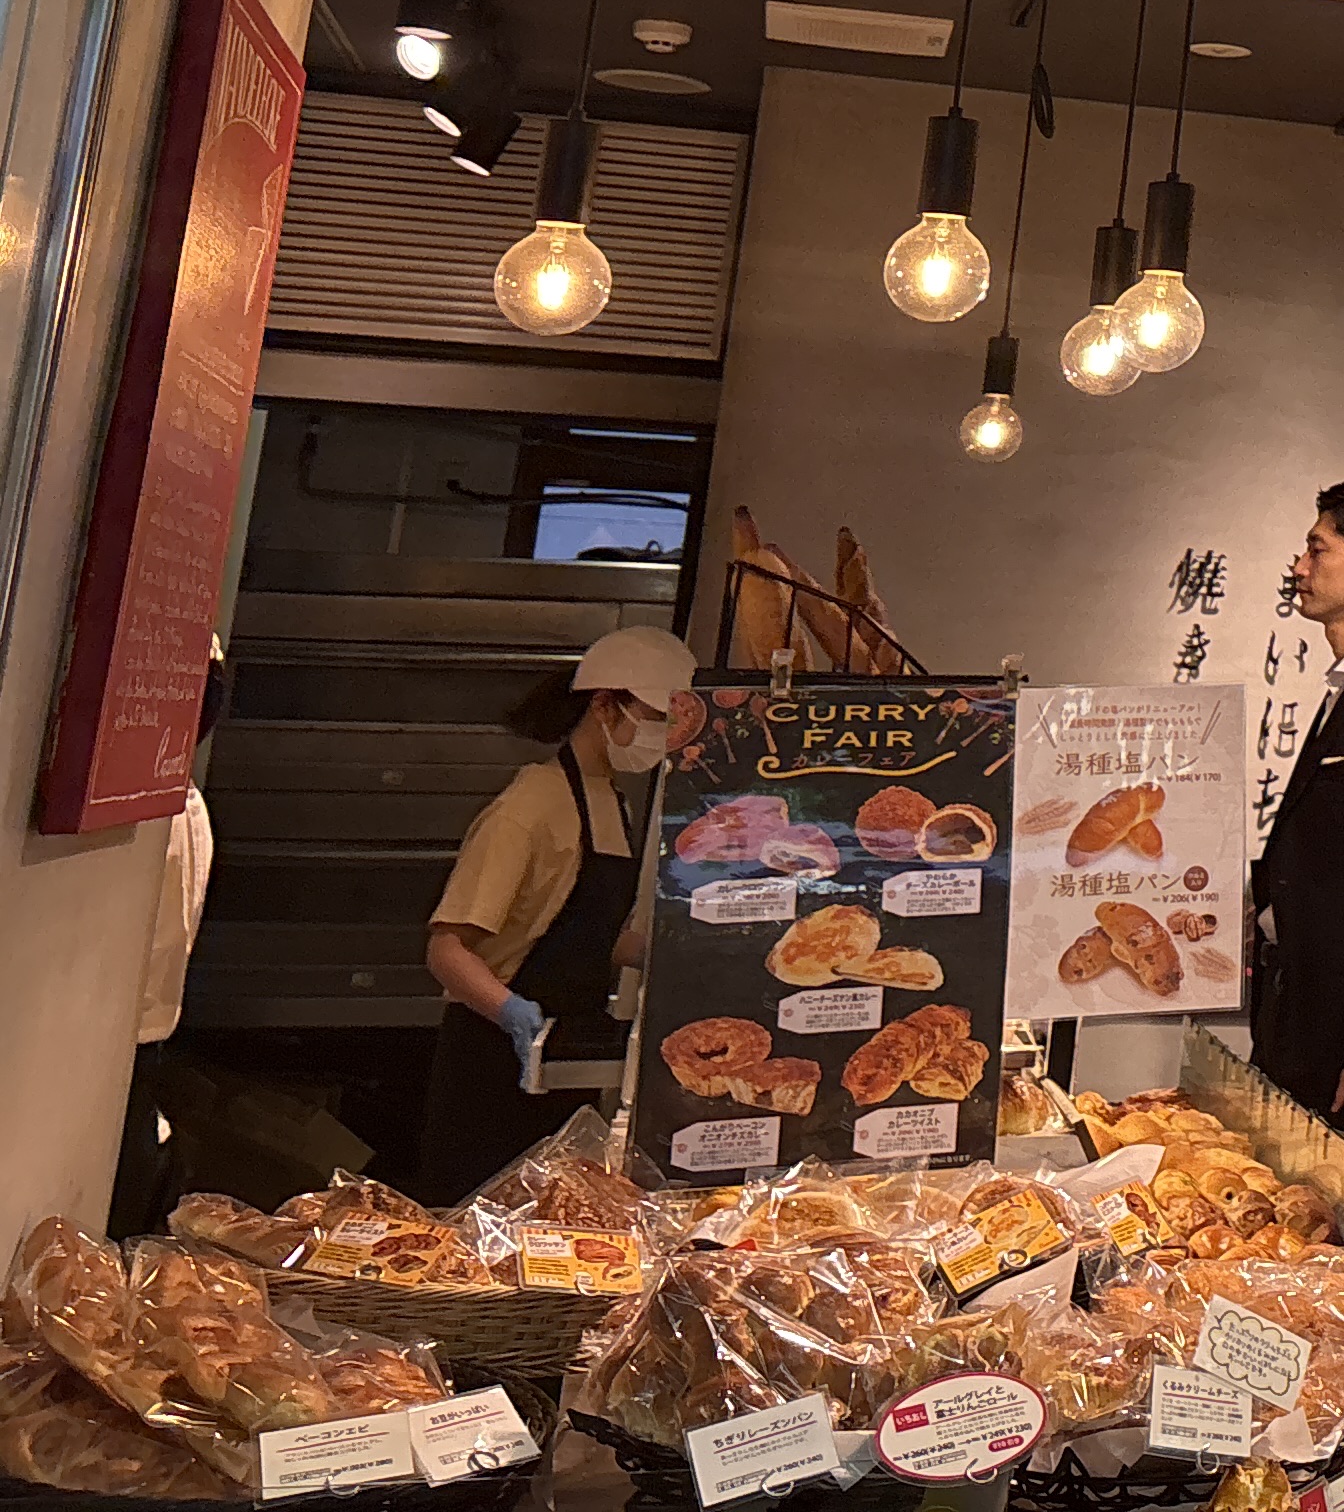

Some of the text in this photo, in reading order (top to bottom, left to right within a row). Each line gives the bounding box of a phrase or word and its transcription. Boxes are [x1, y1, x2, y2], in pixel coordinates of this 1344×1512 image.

[765, 702, 938, 723] CURRY
[801, 728, 915, 749] FAIR
[1055, 750, 1200, 777] 湯種塩パン
[1050, 871, 1182, 898] 湯種塩パン
[932, 1384, 1005, 1409] アールグレイと
[934, 1392, 1018, 1419] 富士りんごロール
[712, 1411, 814, 1448] ちぎりレーズンパン
[895, 1413, 927, 1426] いちおし
[294, 1423, 370, 1443] ベーコンエピ
